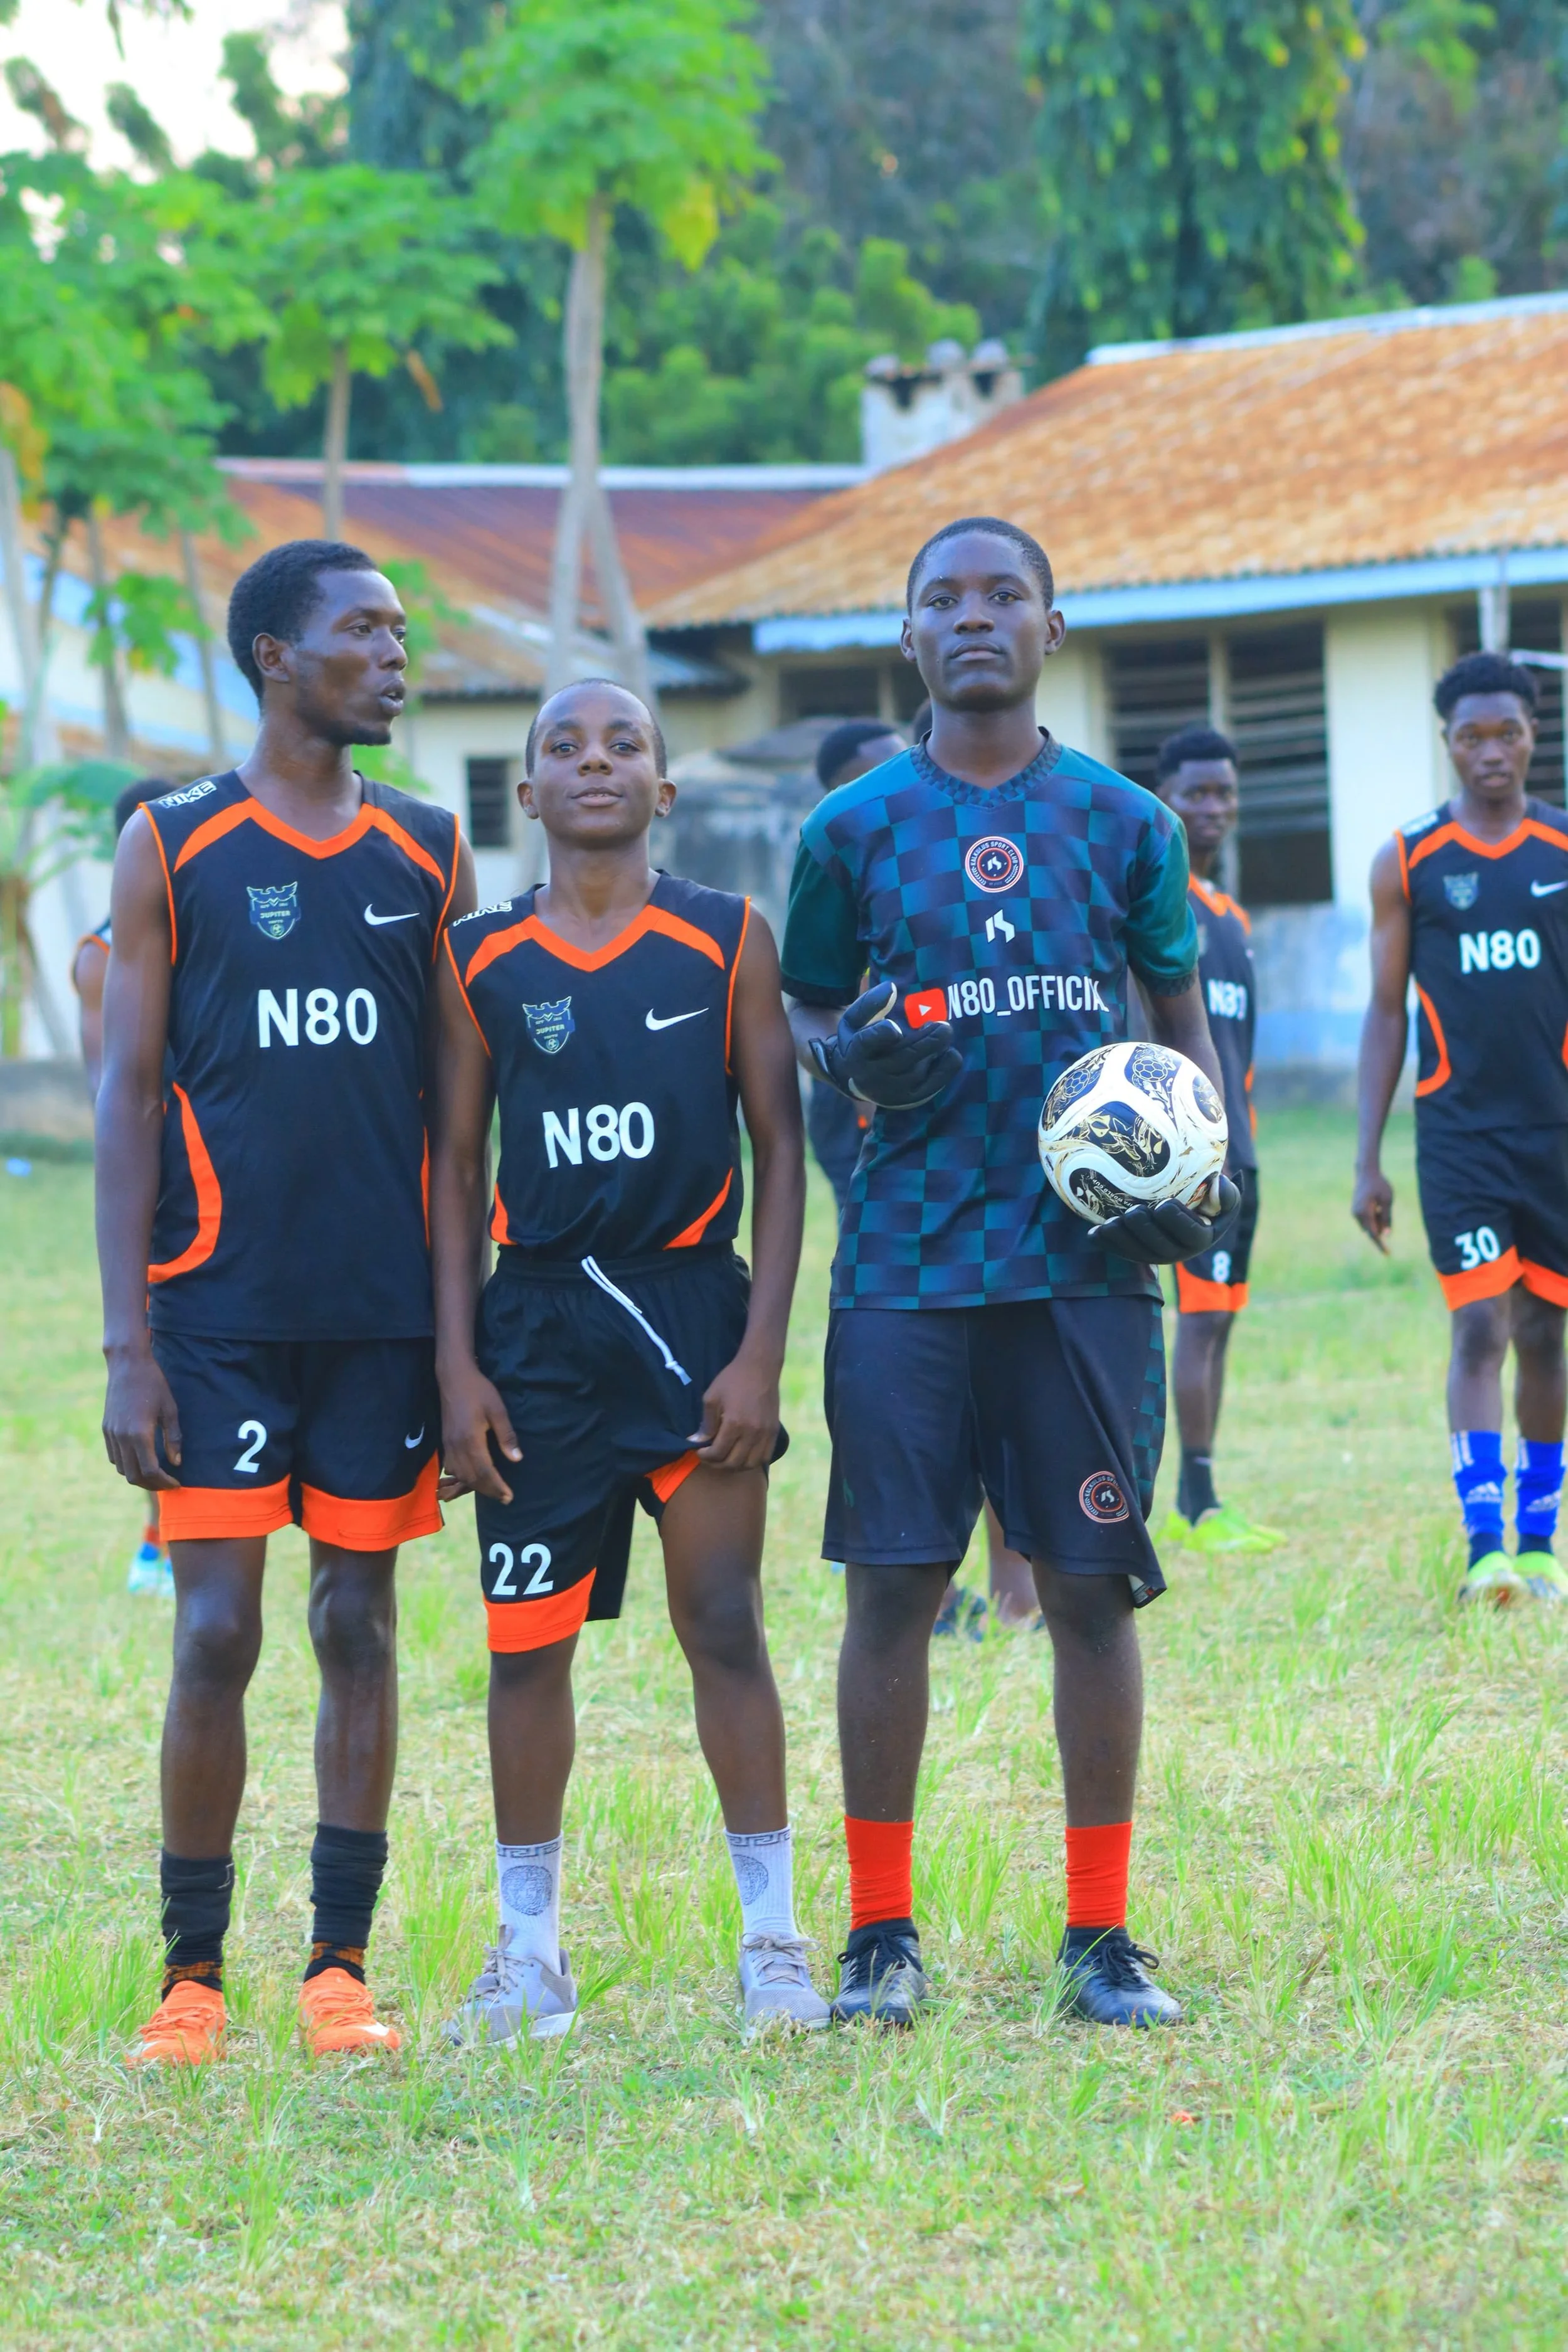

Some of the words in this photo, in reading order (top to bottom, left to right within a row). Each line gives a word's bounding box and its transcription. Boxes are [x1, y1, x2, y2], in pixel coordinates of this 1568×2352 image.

[158, 781, 217, 808] NIKE
[990, 841, 1010, 850] SPORT
[1459, 928, 1541, 974] N80
[257, 988, 378, 1048] N80
[536, 1024, 565, 1035] JUPITER
[543, 1102, 655, 1169] N80
[1092, 1179, 1104, 1189] CUP
[1103, 1188, 1123, 1203] WORLD
[1212, 1250, 1231, 1284] 8
[1454, 1225, 1500, 1271] 30
[233, 1419, 267, 1473] 2
[489, 1542, 554, 1596] 22
